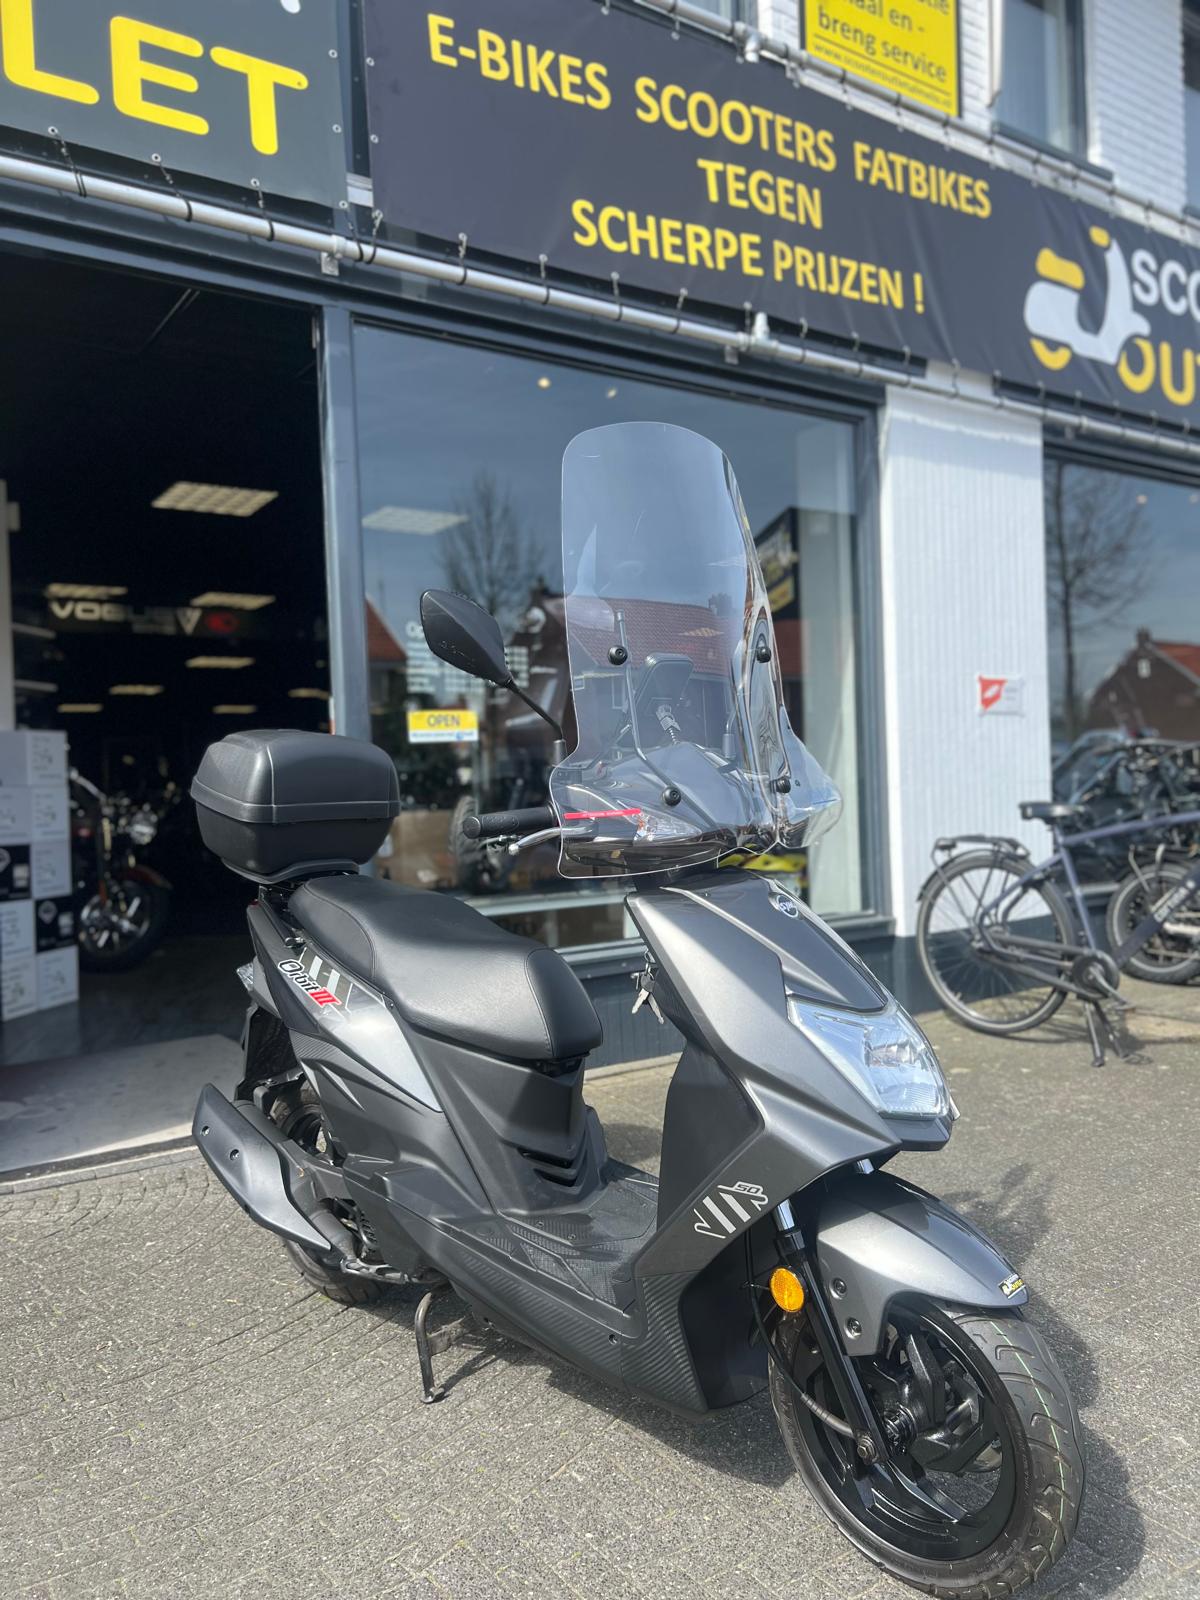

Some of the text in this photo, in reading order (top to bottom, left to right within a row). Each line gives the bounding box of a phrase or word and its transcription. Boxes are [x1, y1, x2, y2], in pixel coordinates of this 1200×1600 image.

[818, 4, 876, 56] breng
[881, 40, 947, 83] service
[888, 8, 913, 32] en
[1, 0, 308, 155] LET
[427, 13, 992, 219] E-BIKES SCOOTERS FATBIKES
[697, 158, 822, 229] TEGEN
[571, 199, 764, 276] SCHERPE
[773, 240, 904, 309] PRIJZEN
[1117, 337, 1200, 406] OU
[427, 714, 460, 727] OPEN
